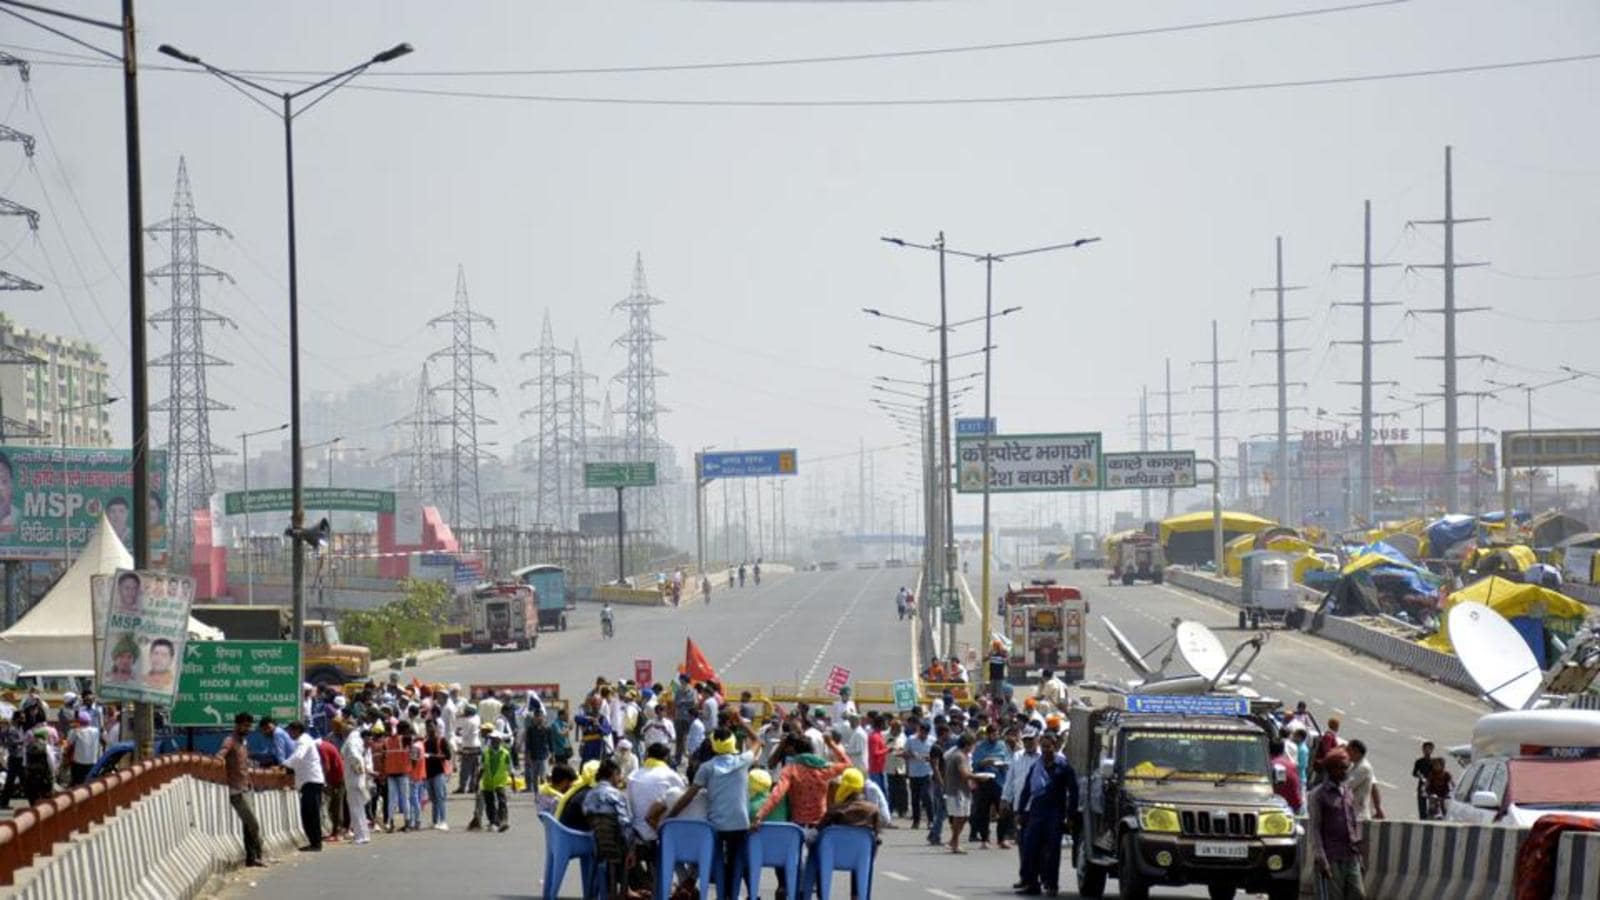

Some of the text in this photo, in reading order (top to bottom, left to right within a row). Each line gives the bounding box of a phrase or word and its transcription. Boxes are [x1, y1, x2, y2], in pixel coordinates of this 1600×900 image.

[1303, 429, 1349, 441] MEDIA
[24, 492, 84, 518] MSP
[111, 614, 143, 630] MSP
[200, 679, 269, 688] HINDON AIRPORT
[247, 693, 296, 702] GHAZIABAD
